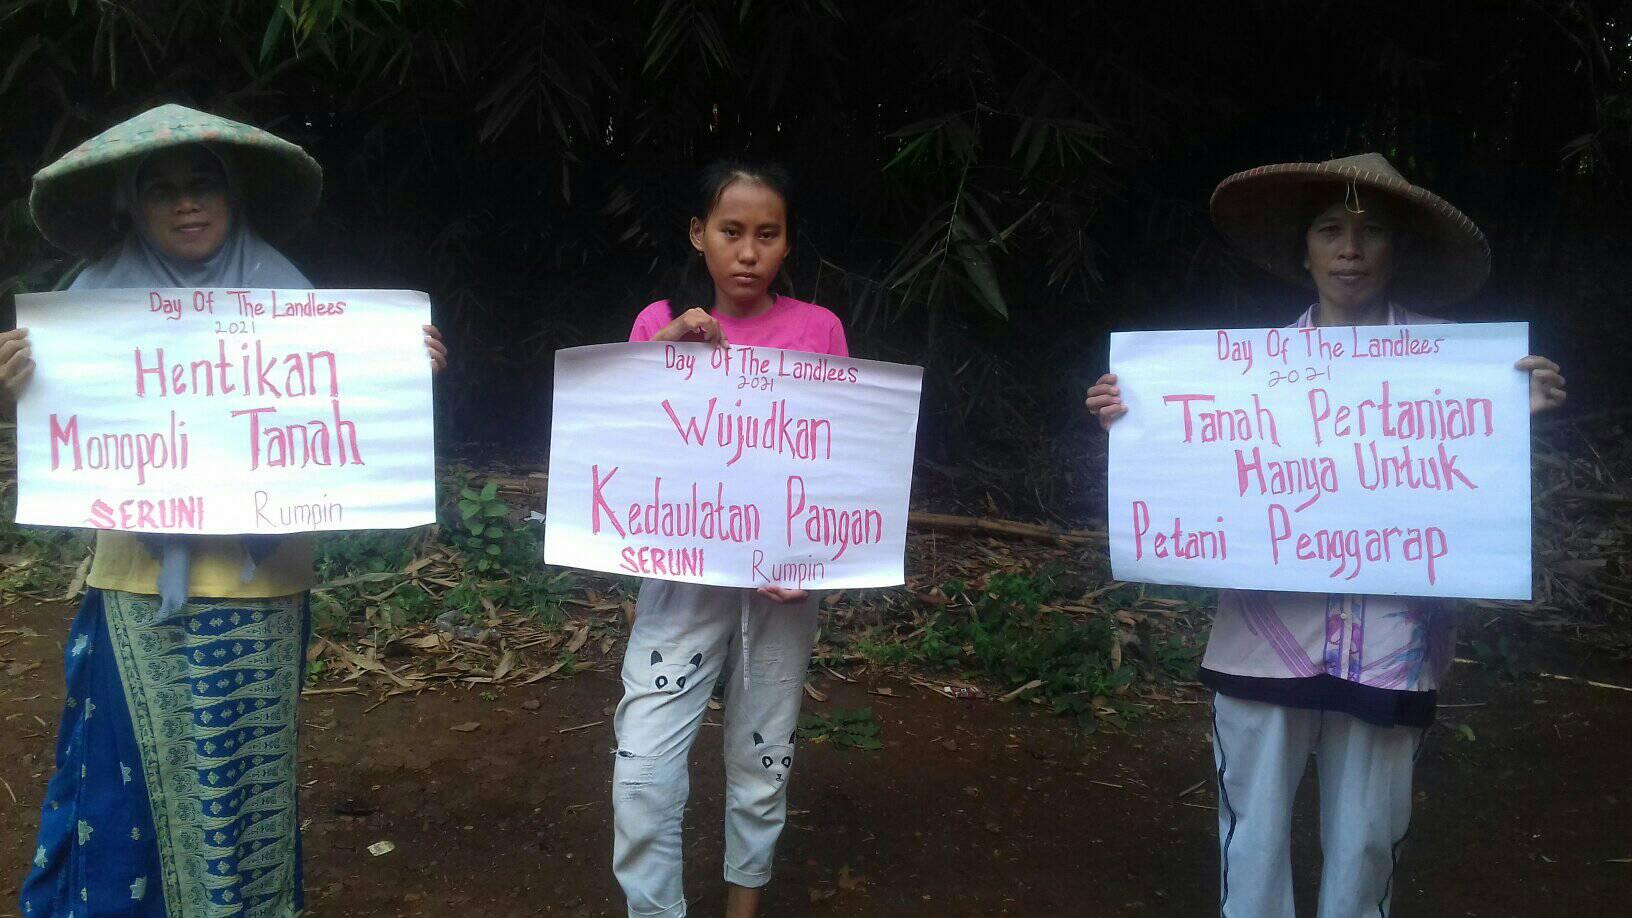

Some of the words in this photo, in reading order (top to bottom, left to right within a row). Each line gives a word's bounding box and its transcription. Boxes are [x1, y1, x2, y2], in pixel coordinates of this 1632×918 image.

[150, 292, 181, 320] Day
[193, 291, 214, 314] Of
[227, 291, 265, 316] The
[273, 291, 347, 317] Landlees
[215, 321, 255, 334] 2021
[135, 339, 339, 398] Hentikan
[666, 345, 695, 380] Day
[738, 348, 770, 375] The
[779, 350, 859, 383] Landlees
[1218, 330, 1253, 375] Day
[1266, 329, 1288, 362] Of
[1299, 327, 1344, 359] The
[1352, 321, 1446, 359] Landlees
[738, 376, 774, 391] 2021
[1268, 365, 1331, 387] 2021
[662, 397, 832, 466] Wujudkan
[1163, 394, 1281, 447] Tanah
[1308, 381, 1494, 446] Pertanian
[49, 410, 189, 485] Monopoli
[230, 399, 366, 471] Tanah
[1234, 446, 1339, 513] Hanya
[1354, 441, 1478, 491] Untuk
[84, 496, 204, 530] SERUNI
[255, 491, 343, 530] Rumpin
[592, 465, 761, 543] Kedaulatan
[787, 476, 882, 561] Pangan
[620, 547, 704, 577] SERUNI
[752, 550, 824, 586] Rumpin
[1133, 501, 1227, 561] Petani
[1268, 503, 1449, 585] Penggarap
